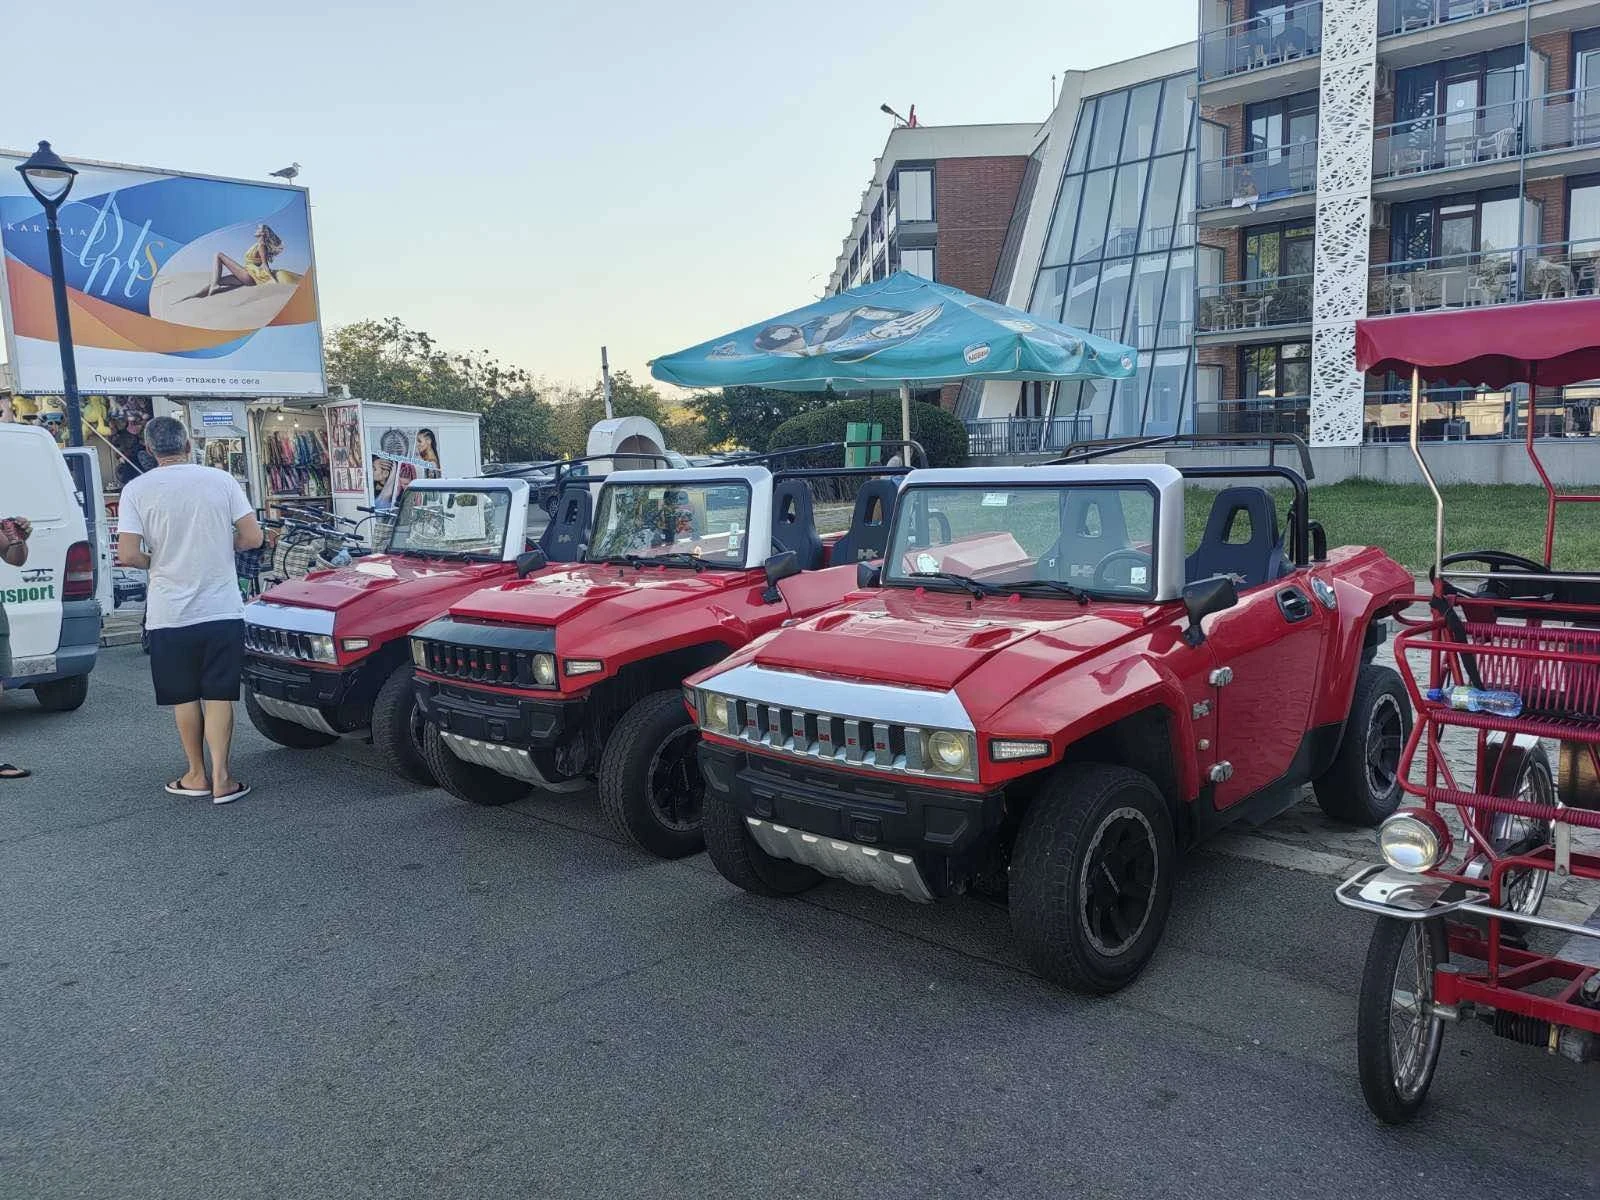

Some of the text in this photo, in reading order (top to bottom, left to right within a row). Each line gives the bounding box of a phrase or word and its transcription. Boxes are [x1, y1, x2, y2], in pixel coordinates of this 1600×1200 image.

[6, 222, 89, 237] KARLIA
[94, 374, 144, 385] Пушенето
[147, 375, 174, 385] убива
